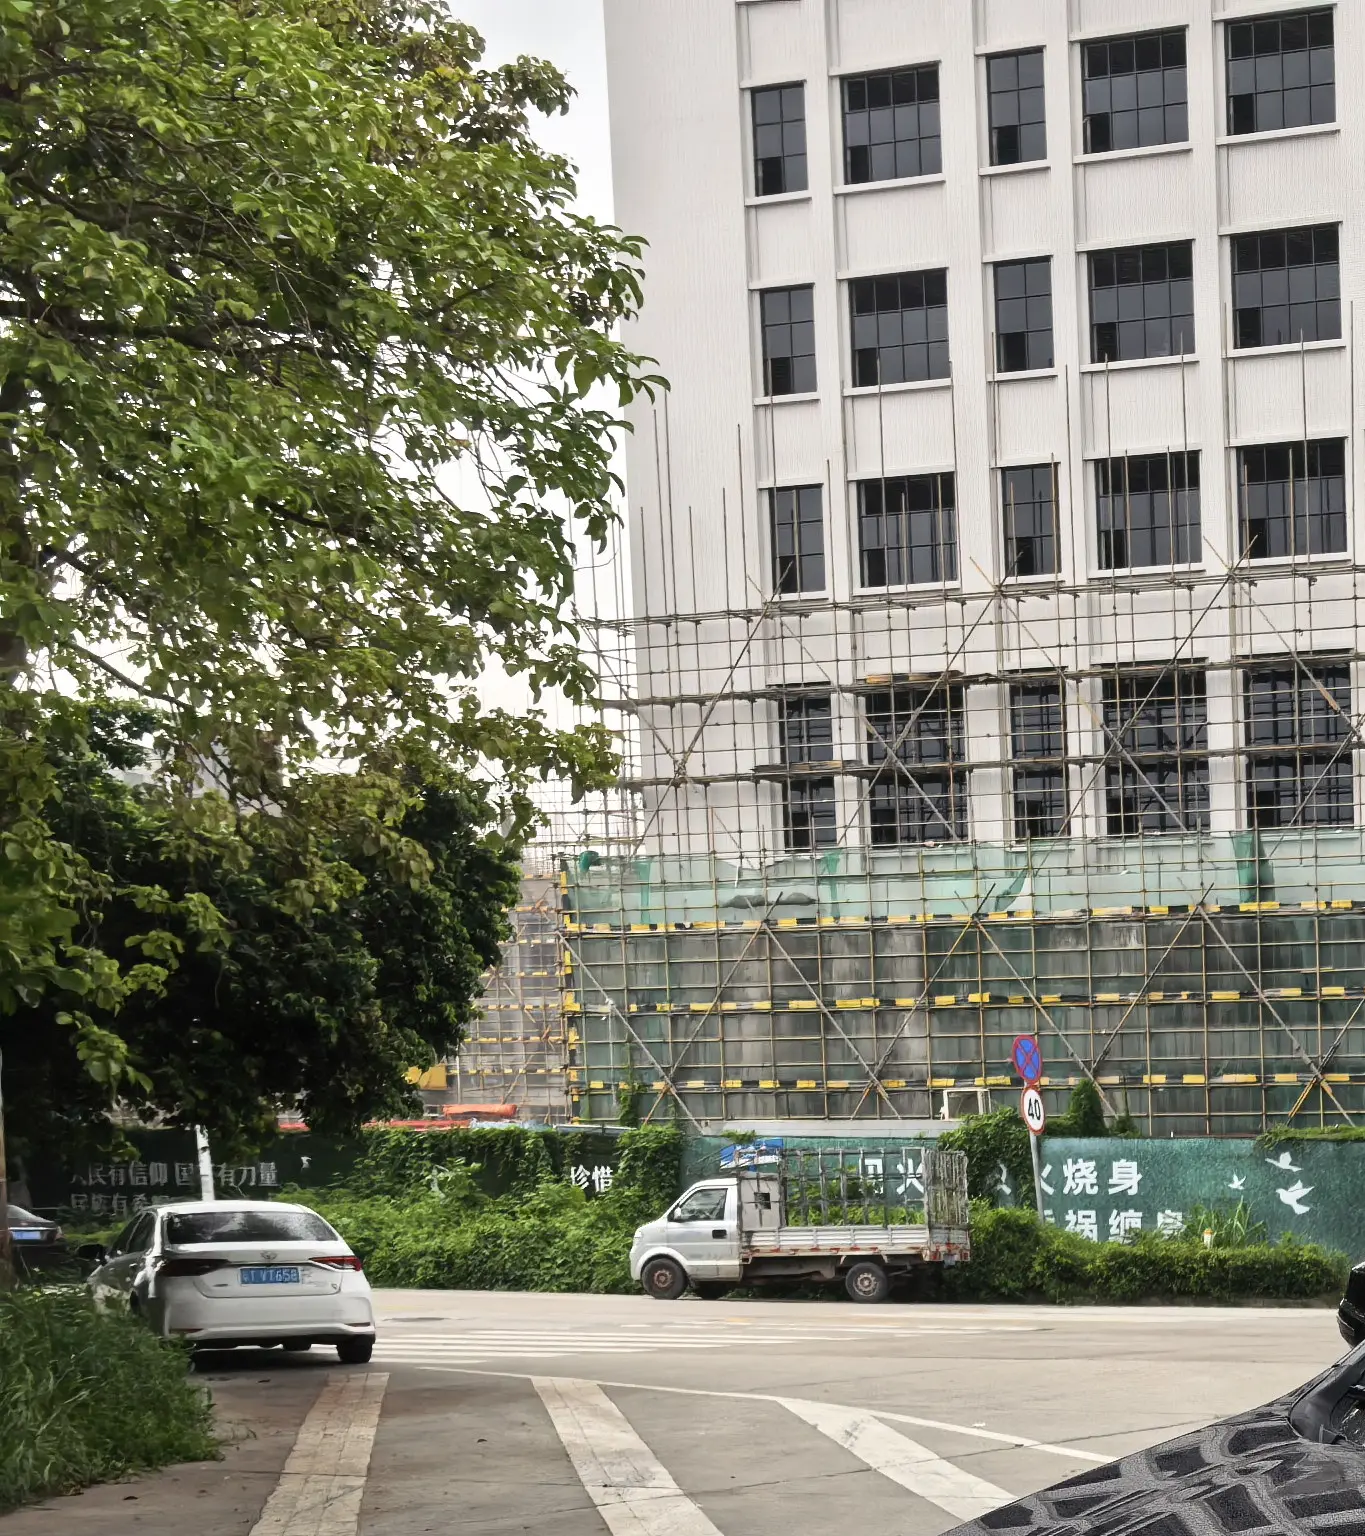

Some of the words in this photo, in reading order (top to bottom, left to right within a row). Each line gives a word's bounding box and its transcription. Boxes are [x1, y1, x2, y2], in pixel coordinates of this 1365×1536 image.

[1027, 1097, 1041, 1121] 40
[174, 1161, 280, 1188] 国有力量
[570, 1164, 613, 1193] 珍惜
